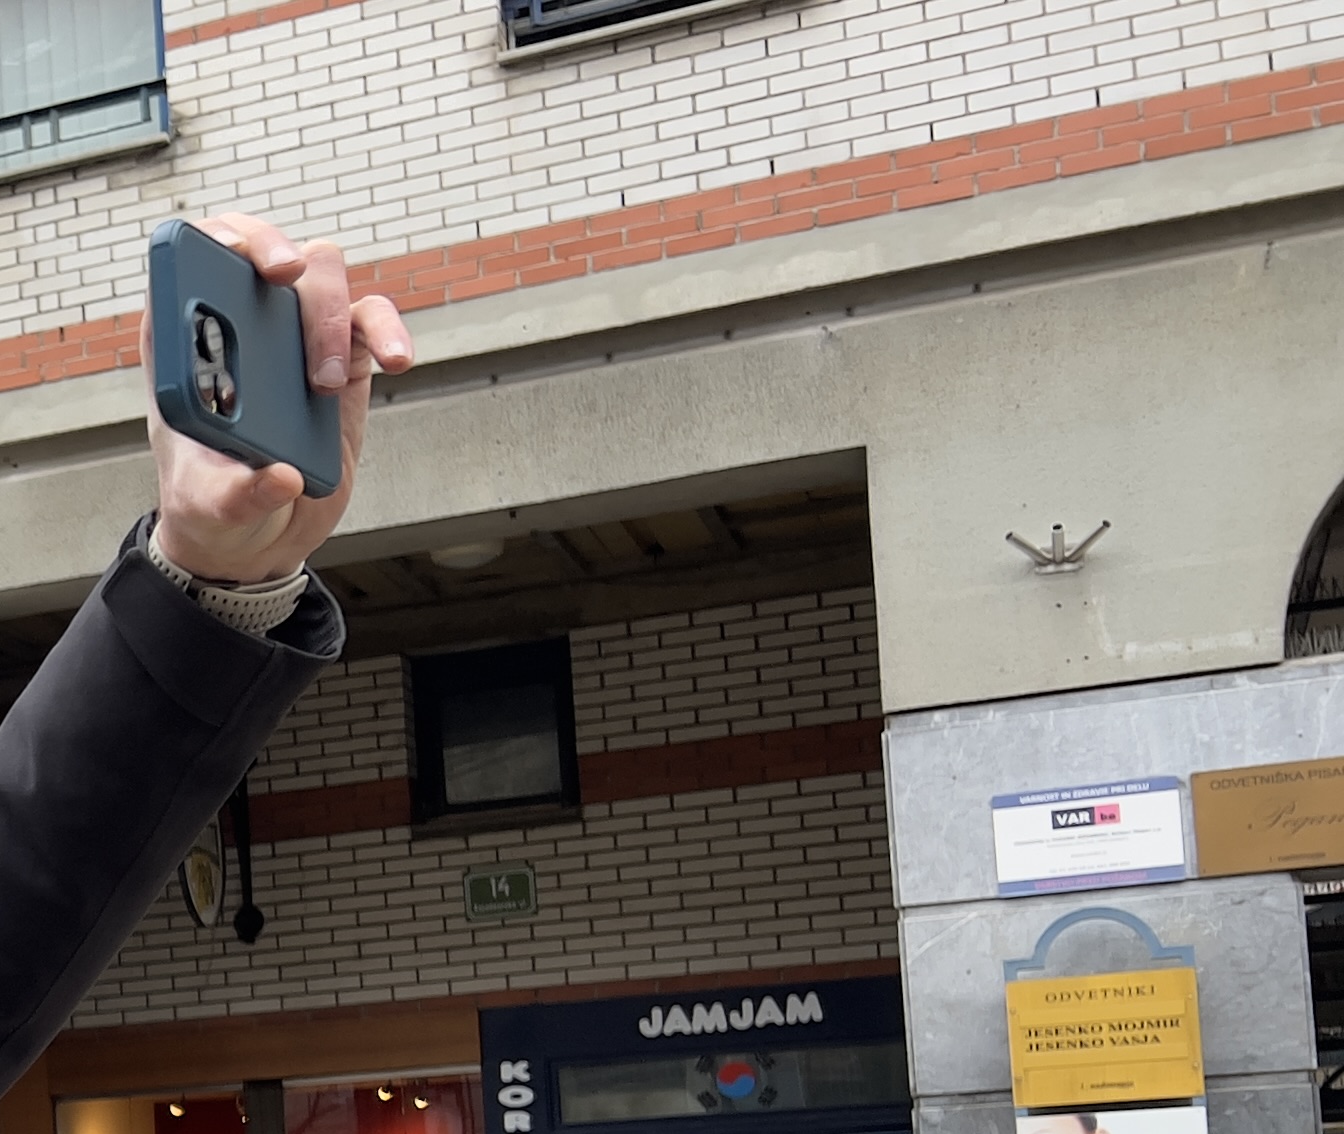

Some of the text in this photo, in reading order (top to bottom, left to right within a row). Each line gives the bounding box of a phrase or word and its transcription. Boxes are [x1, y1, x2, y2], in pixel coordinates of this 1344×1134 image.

[1210, 770, 1304, 791] ODVETNIŠKA
[1056, 810, 1091, 826] VAR
[490, 875, 510, 899] 14
[1045, 984, 1156, 1003] ODVETNIKI
[638, 992, 824, 1038] JAMJAM
[1025, 1017, 1181, 1039] JESENKO MOJMIR
[1026, 1036, 1104, 1053] JESENKO
